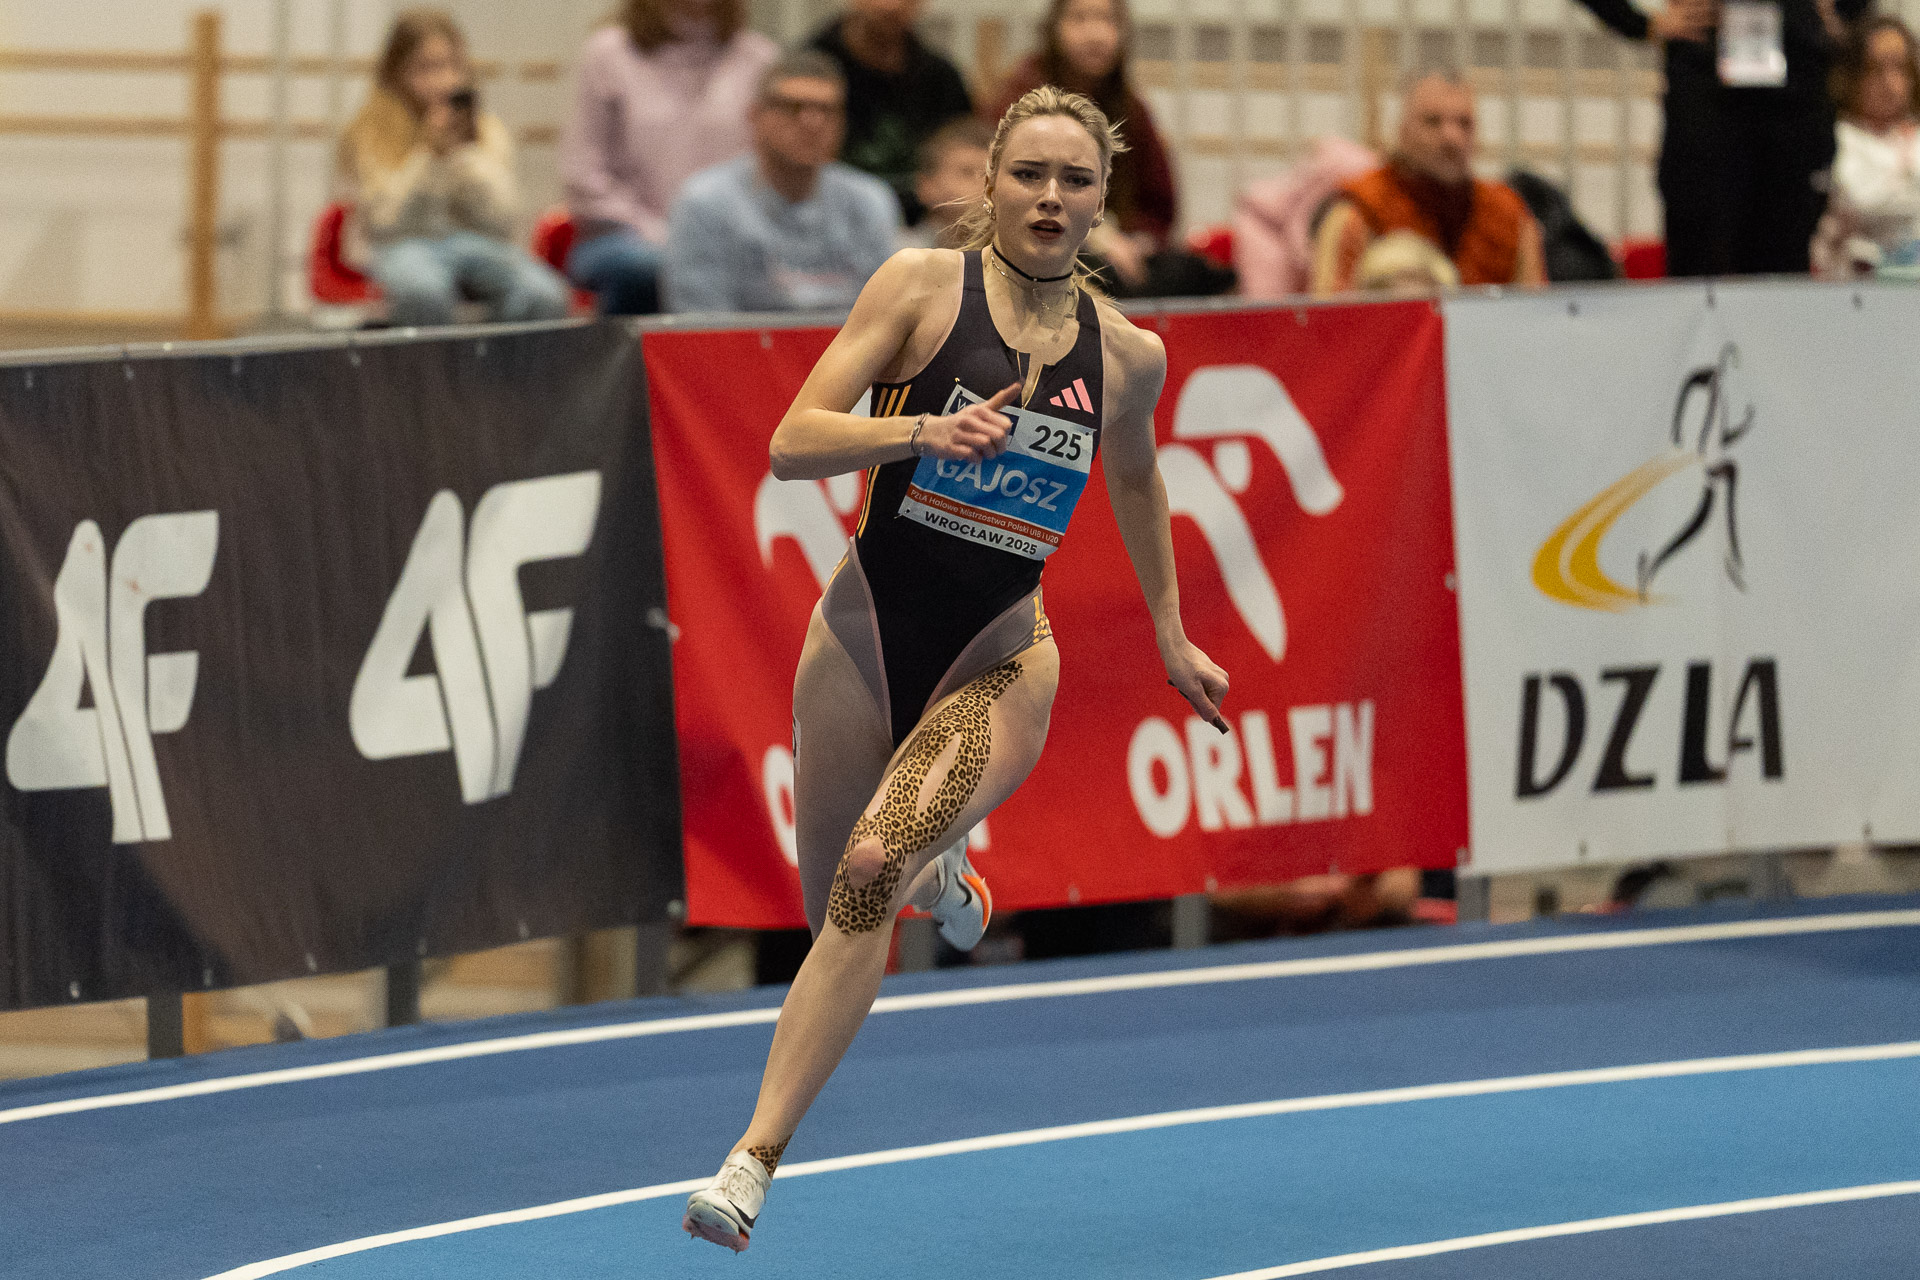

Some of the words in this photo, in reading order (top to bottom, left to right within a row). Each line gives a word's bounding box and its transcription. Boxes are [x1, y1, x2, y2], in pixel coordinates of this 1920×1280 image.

[935, 458, 1068, 512] GAJOSZ
[1029, 424, 1082, 461] 225
[910, 489, 928, 502] PZLA
[928, 496, 959, 513] Halowe
[959, 507, 1006, 526] Mistrzostwa
[1007, 521, 1030, 534] Polski
[1029, 528, 1041, 538] U18
[1045, 534, 1059, 544] U20
[925, 511, 1004, 544] WROCŁAW
[1005, 536, 1038, 555] 2025
[5, 509, 220, 844] 4F
[350, 469, 602, 805] 4F
[1127, 700, 1375, 839] ORLEN
[1514, 654, 1785, 801] DZLA
